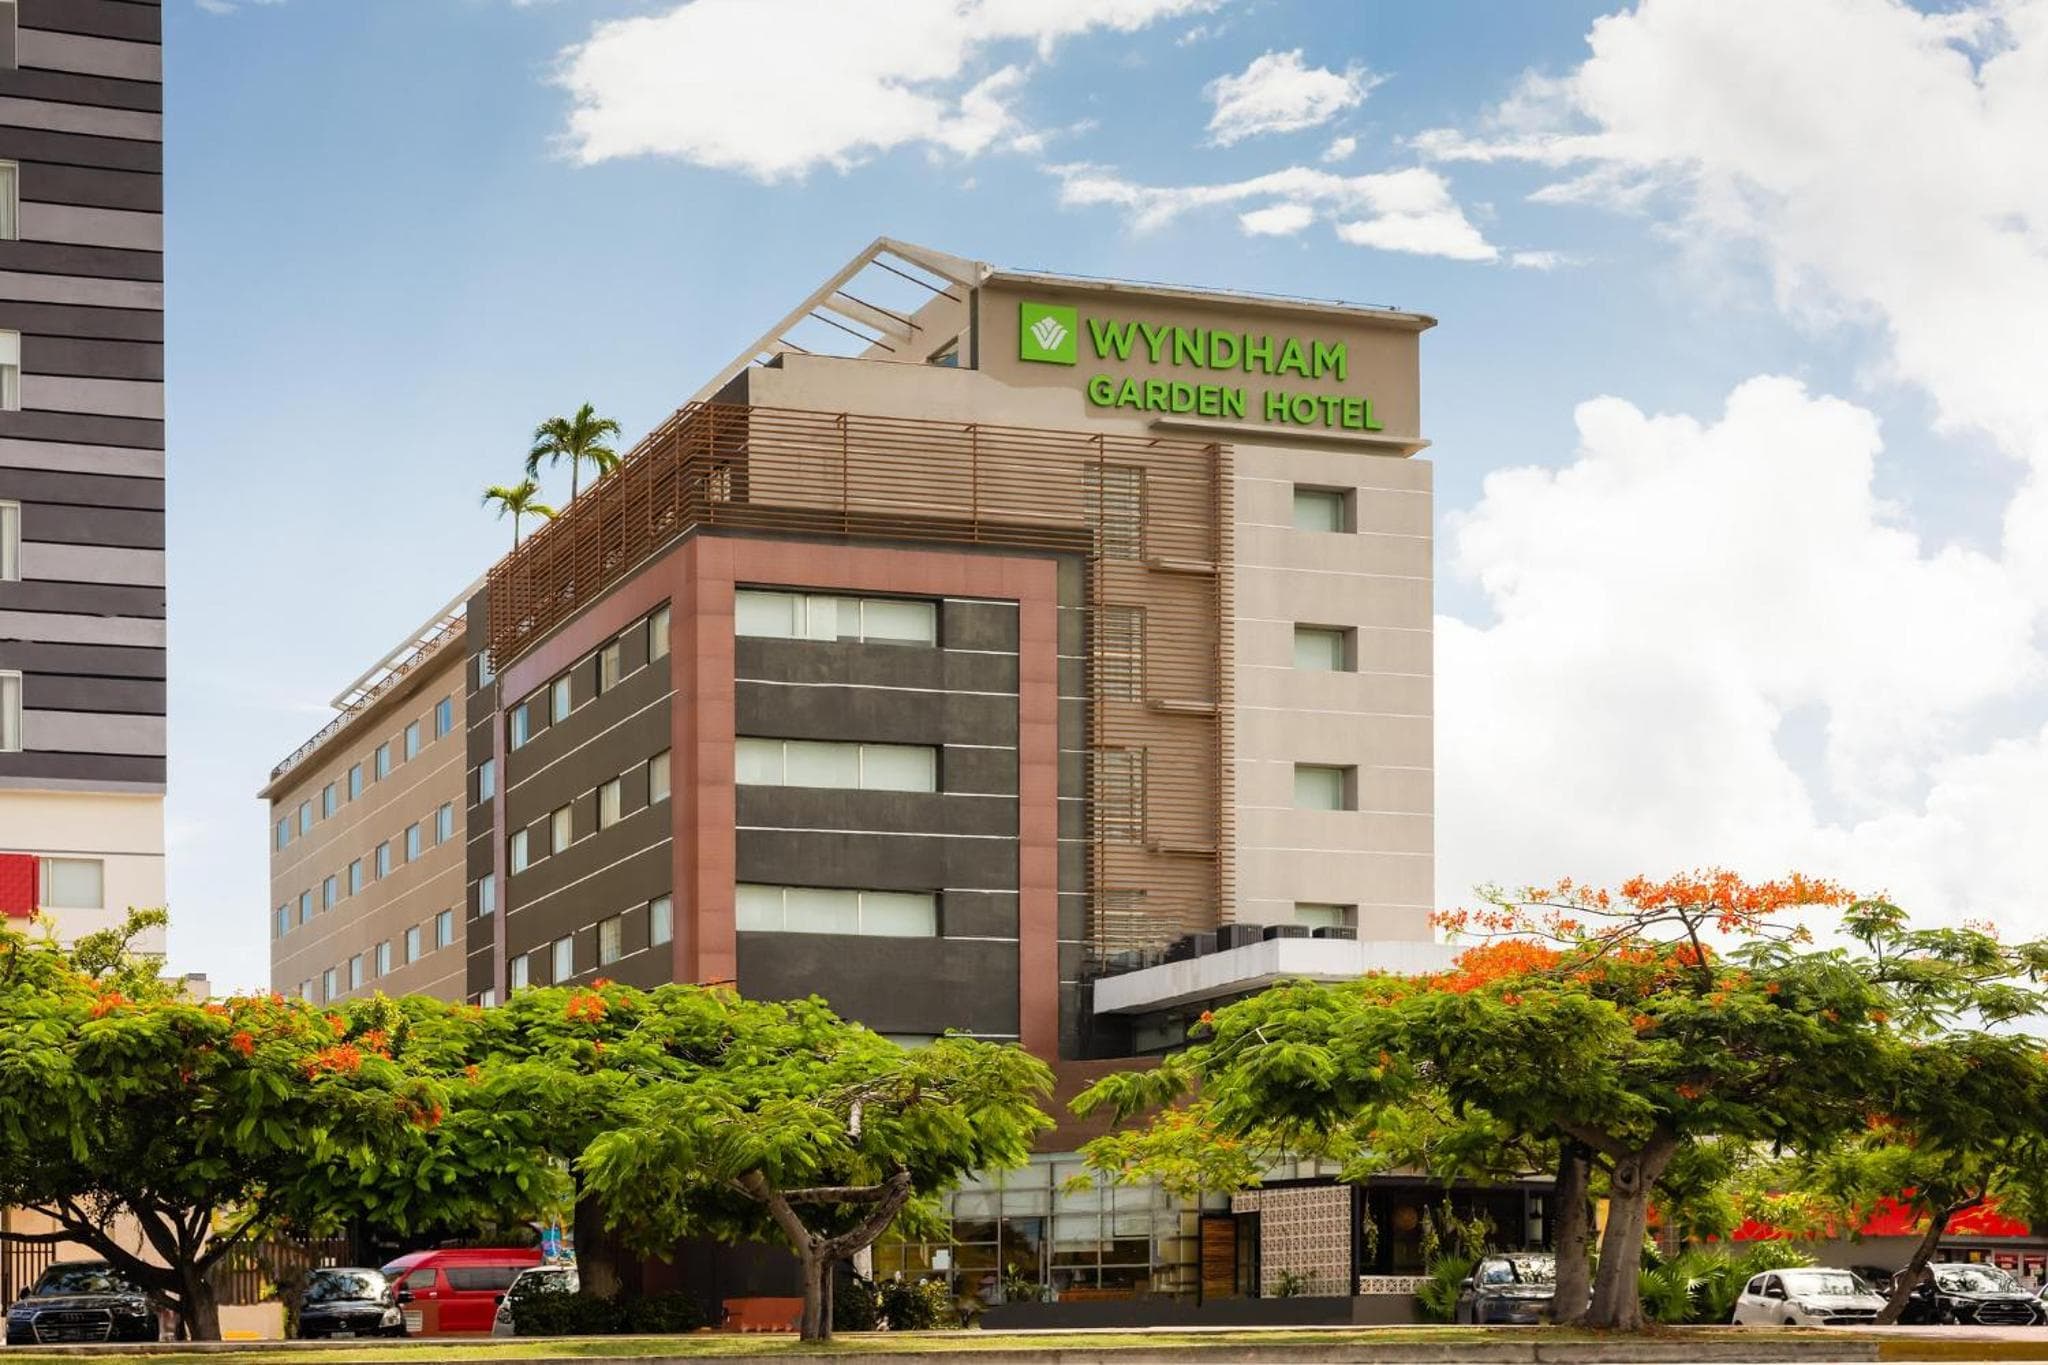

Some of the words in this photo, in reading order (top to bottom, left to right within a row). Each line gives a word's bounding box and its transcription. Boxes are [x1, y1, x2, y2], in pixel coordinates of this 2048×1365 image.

[1087, 317, 1348, 381] WYNDHAM
[1087, 374, 1247, 418] GARDEN
[1264, 390, 1383, 431] HOTEL
